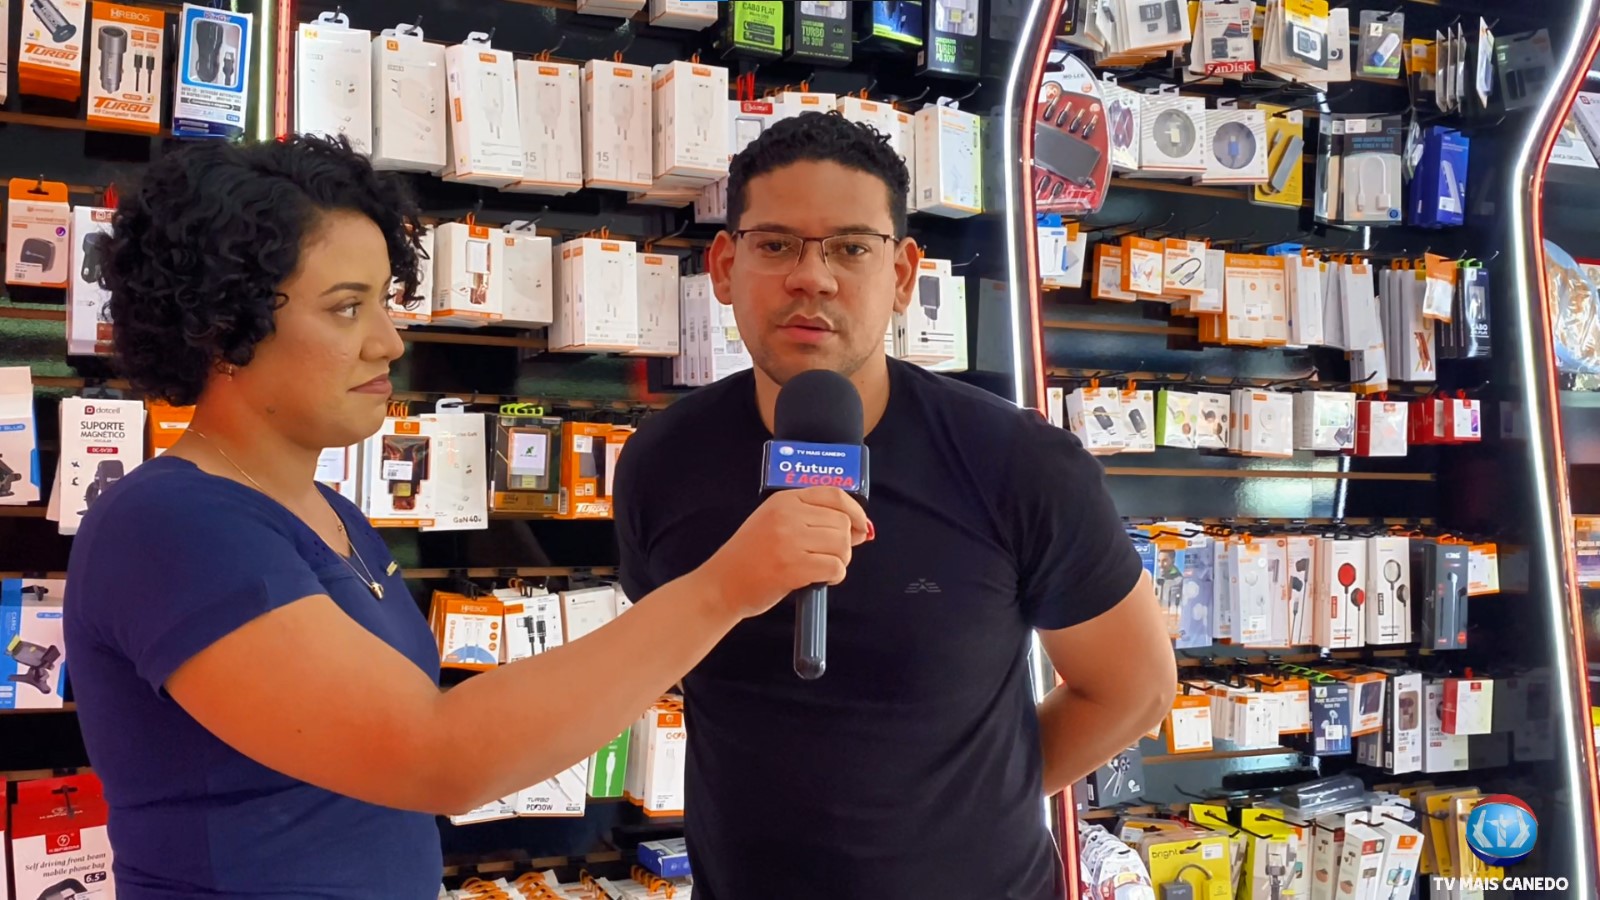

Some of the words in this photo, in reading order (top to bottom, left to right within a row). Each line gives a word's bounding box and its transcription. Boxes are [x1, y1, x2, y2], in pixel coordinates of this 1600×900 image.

[761, 6, 775, 15] FLAT
[802, 26, 825, 37] TURBO
[24, 42, 79, 61] TURBO
[1207, 62, 1252, 74] SanDisk
[93, 96, 153, 113] TURBO
[524, 152, 537, 162] 15
[596, 152, 609, 162] 15
[80, 421, 125, 431] SUPORTE
[80, 430, 126, 439] MAGNÉTICO
[779, 461, 792, 472] O
[795, 462, 844, 475] futuro
[798, 474, 854, 487] AGORA
[1151, 848, 1178, 859] bright
[25, 863, 39, 871] Self
[40, 859, 66, 869] driving
[67, 855, 85, 865] front
[87, 852, 106, 861] beam
[43, 867, 67, 877] mobile
[69, 863, 90, 874] phone
[92, 862, 105, 871] bag
